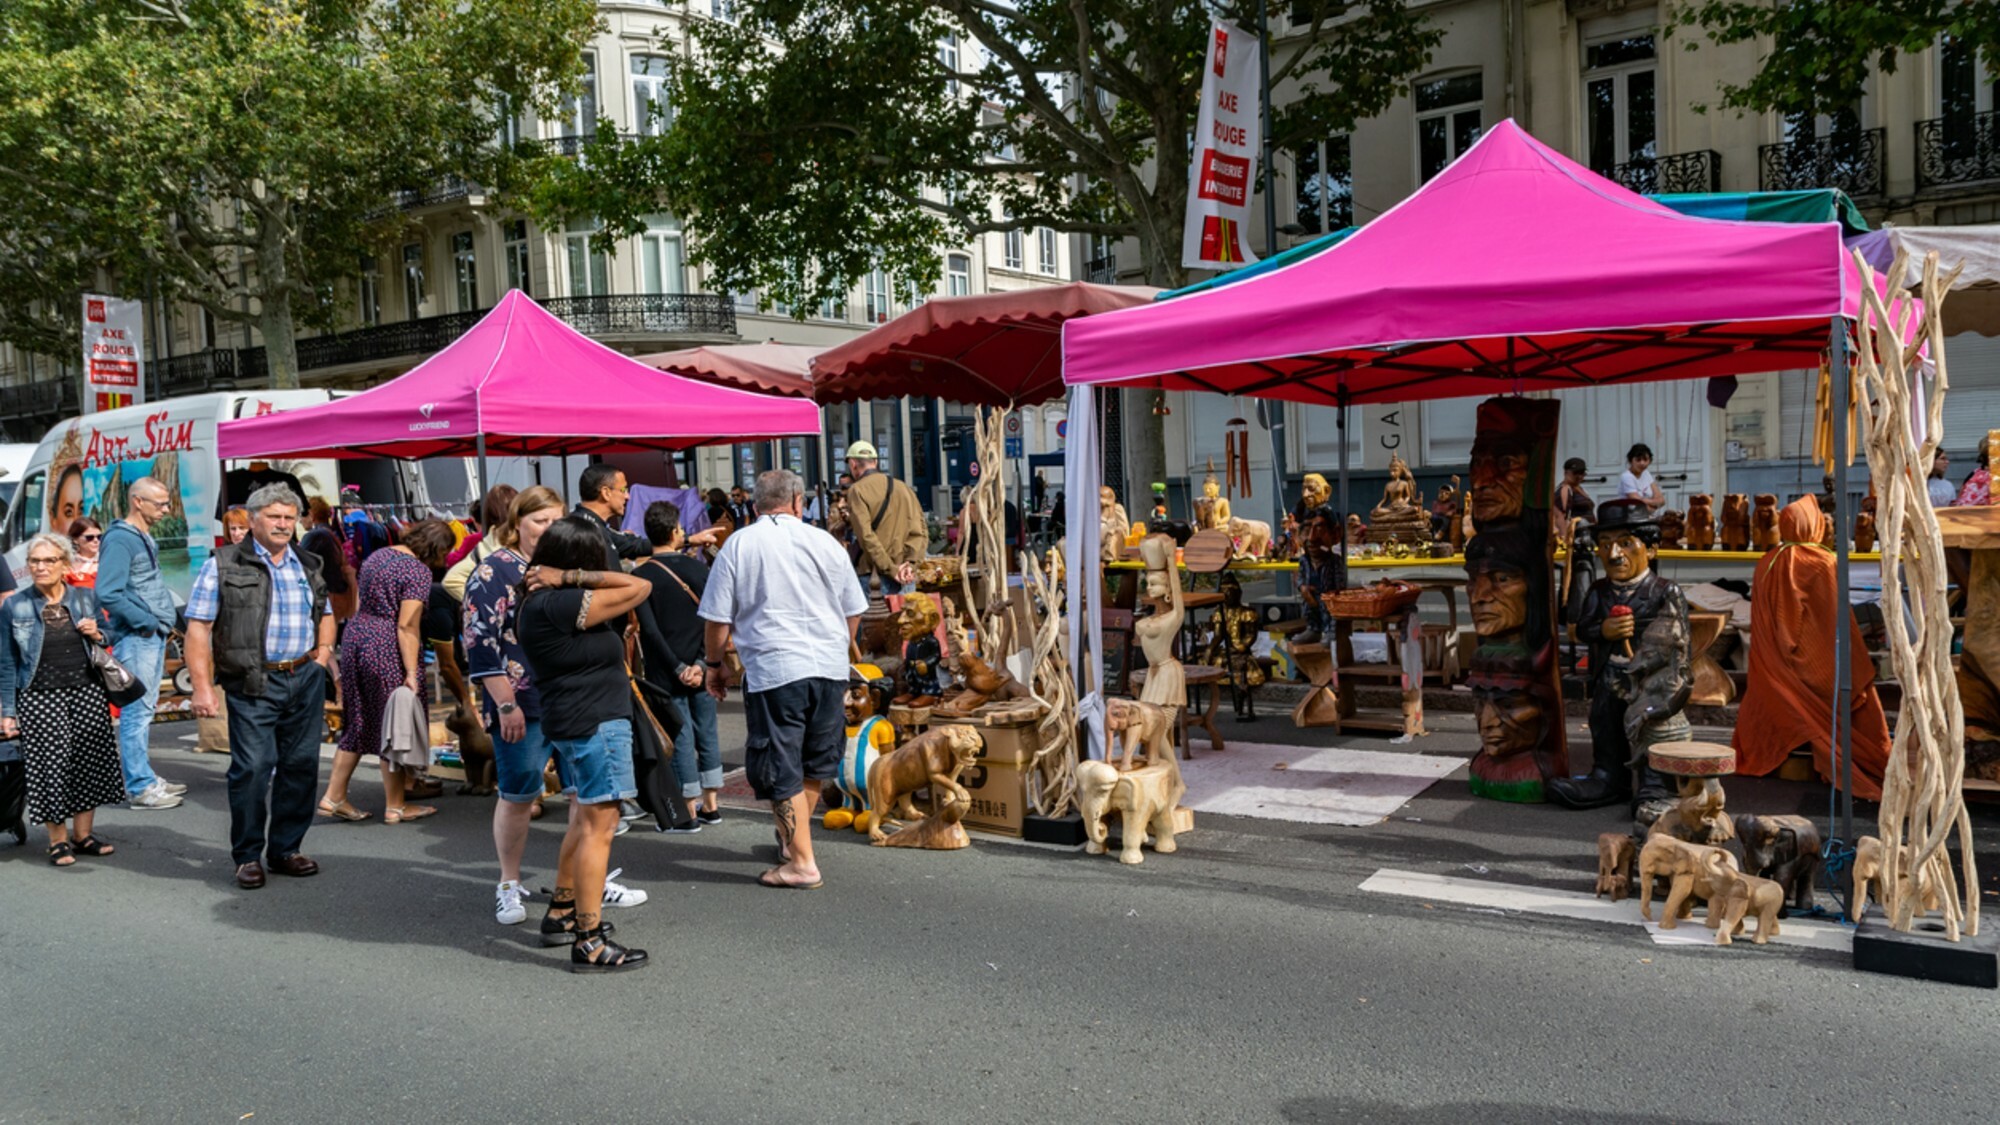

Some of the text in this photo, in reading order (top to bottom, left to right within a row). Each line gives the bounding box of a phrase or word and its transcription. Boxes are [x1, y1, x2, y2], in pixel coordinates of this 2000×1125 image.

[1218, 90, 1238, 114] AXE
[1213, 119, 1247, 147] ROUGE
[102, 328, 124, 340] AXE
[93, 343, 134, 356] ROUGE
[1380, 402, 1401, 449] GA
[967, 798, 1008, 820] 子有限公司
